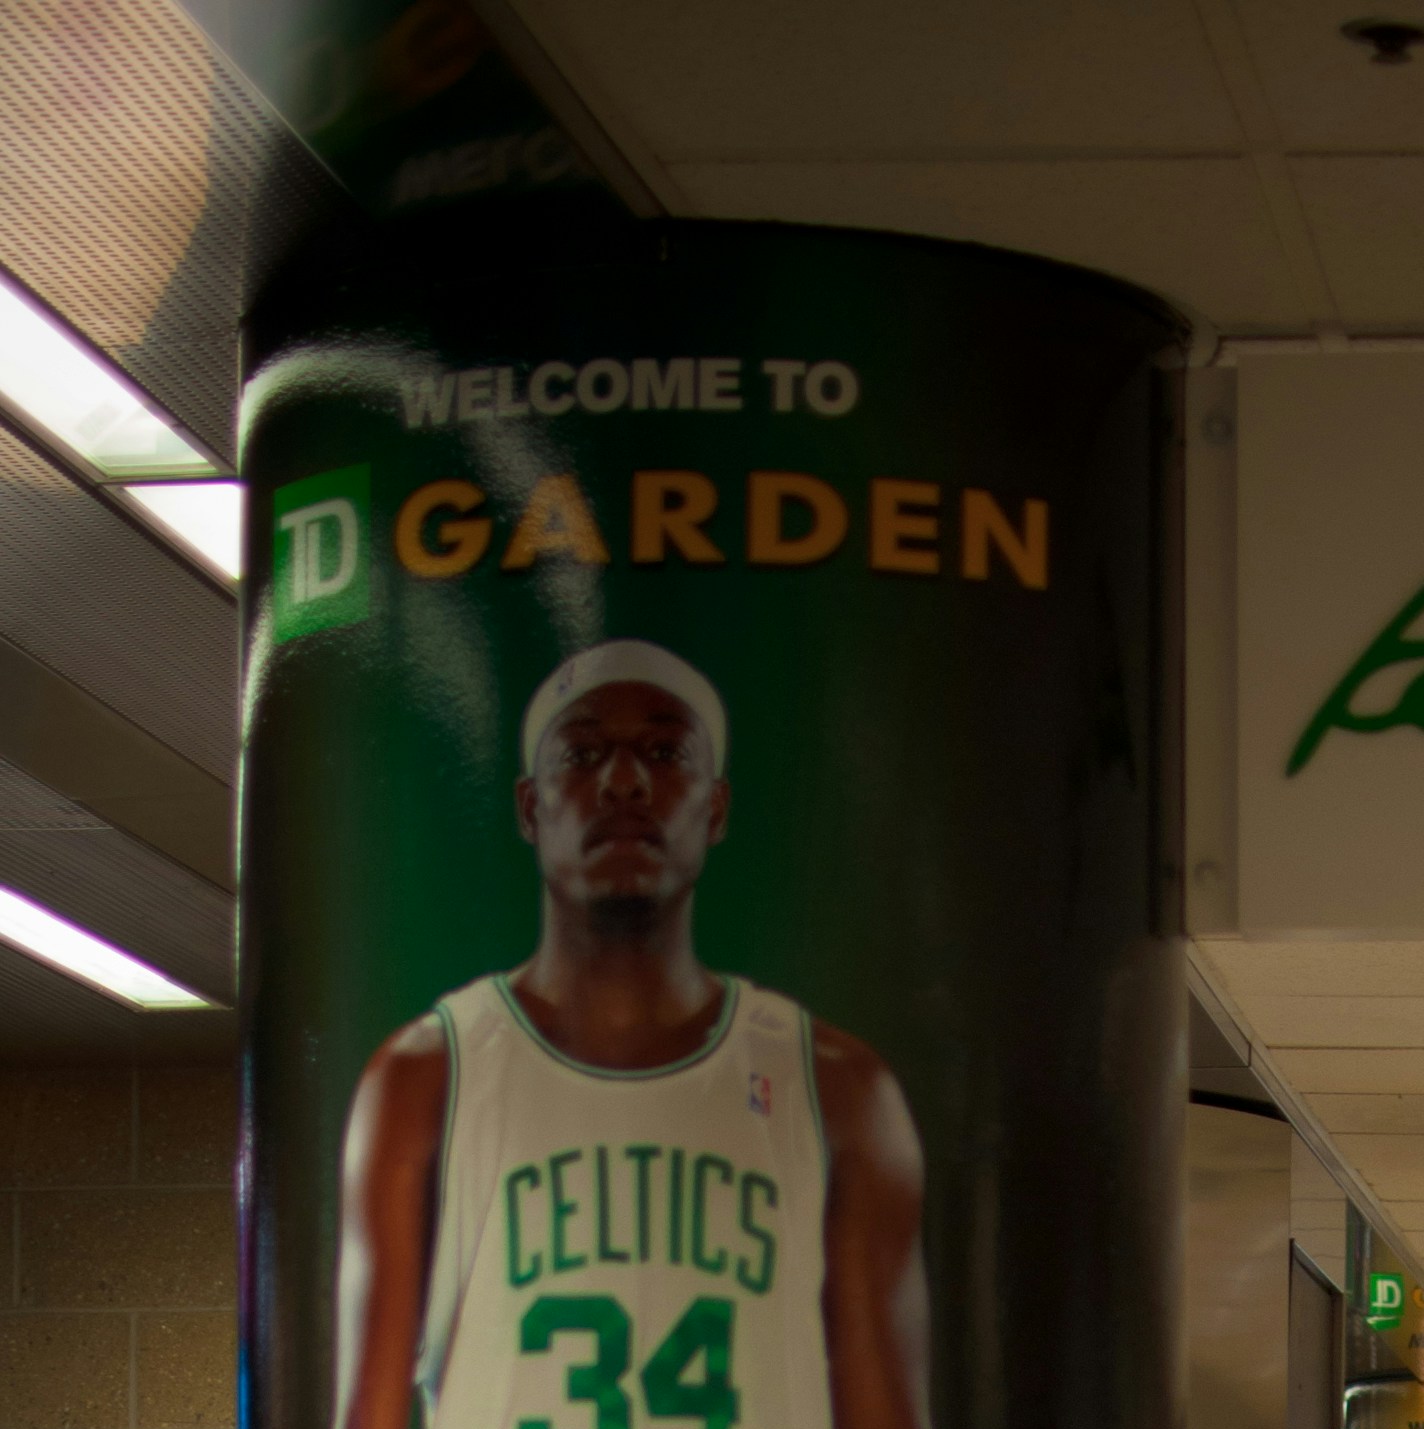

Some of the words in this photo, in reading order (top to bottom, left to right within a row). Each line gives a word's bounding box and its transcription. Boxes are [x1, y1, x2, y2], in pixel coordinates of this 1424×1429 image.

[404, 358, 742, 428] WELCOME
[763, 360, 860, 416] TO
[280, 498, 359, 604] TD
[394, 470, 1049, 590] GARDEN
[505, 1145, 779, 1295] CELTICS
